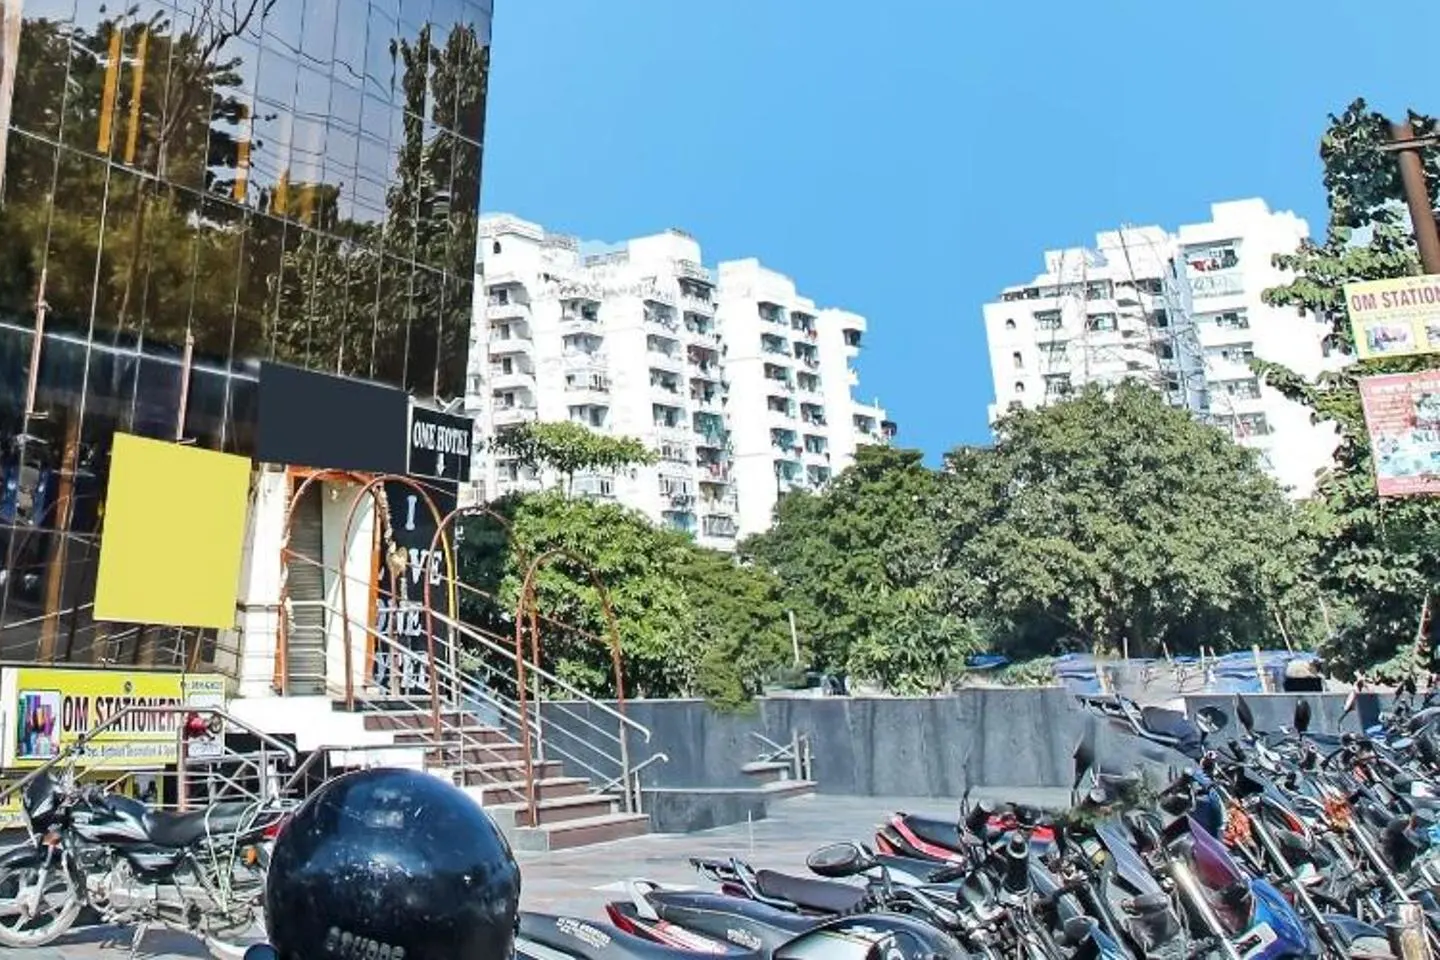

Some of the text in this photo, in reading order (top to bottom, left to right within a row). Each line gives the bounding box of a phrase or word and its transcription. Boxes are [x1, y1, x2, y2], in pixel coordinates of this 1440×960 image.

[1351, 293, 1378, 312] OM
[413, 421, 437, 450] ONE
[63, 695, 89, 732] OM
